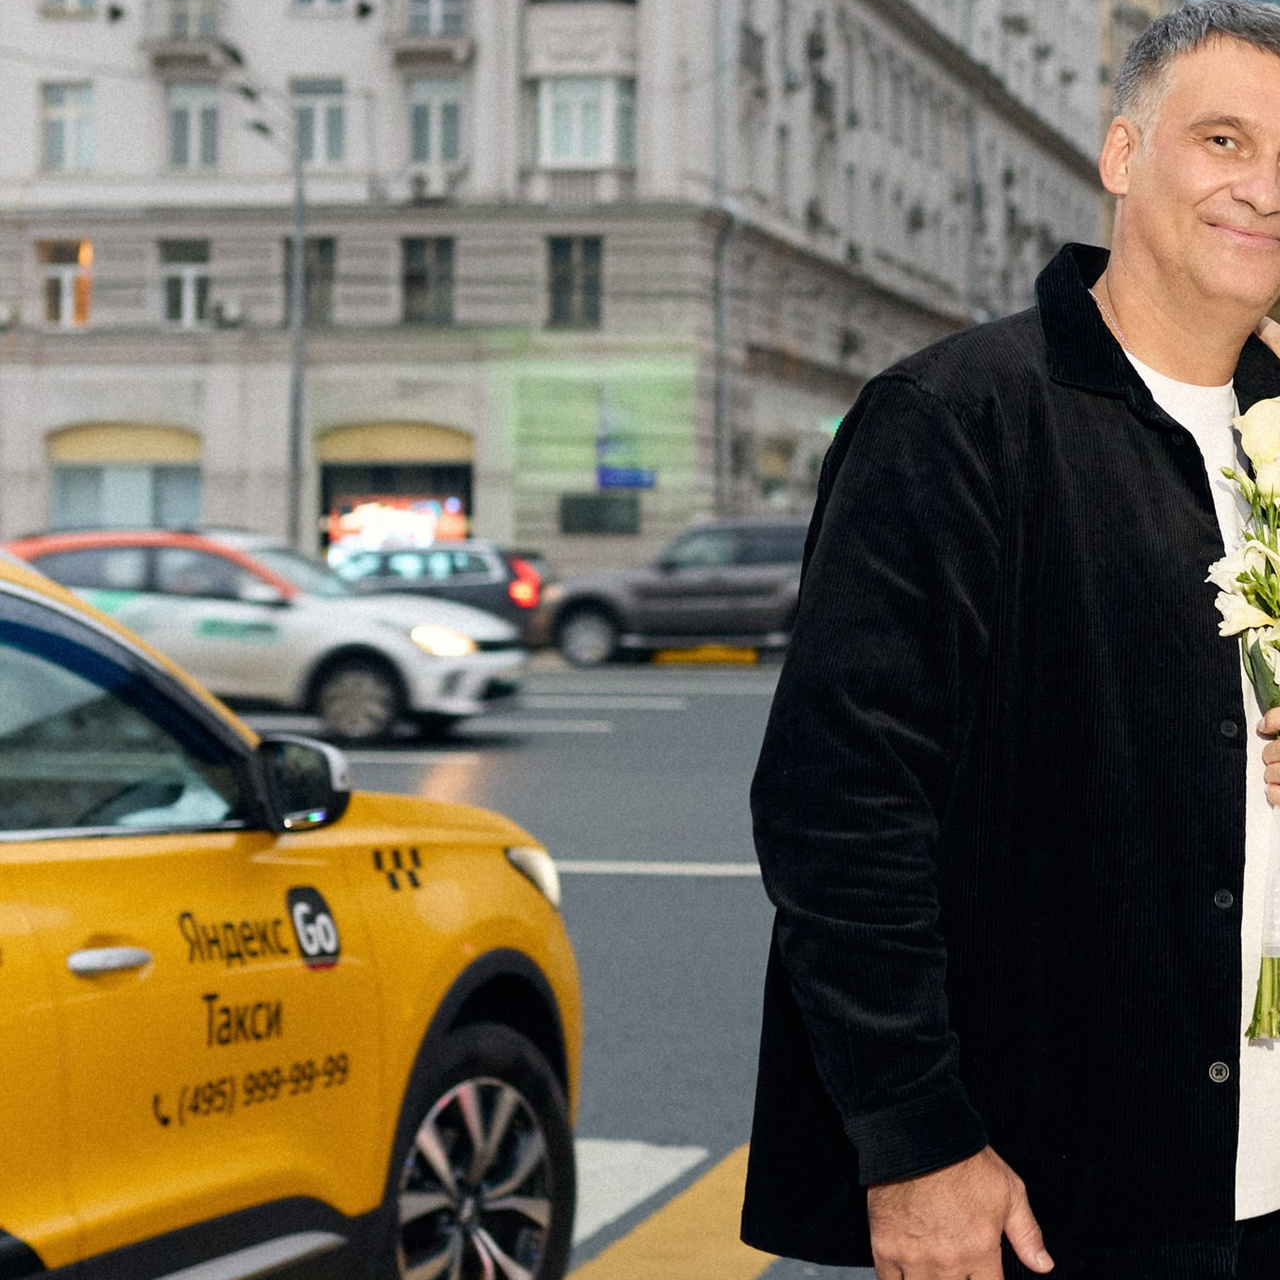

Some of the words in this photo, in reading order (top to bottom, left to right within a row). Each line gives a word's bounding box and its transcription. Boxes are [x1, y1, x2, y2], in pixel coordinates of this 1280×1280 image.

[178, 911, 289, 967] Яндекс
[292, 901, 341, 956] Go
[202, 993, 283, 1048] Такси
[177, 1076, 236, 1127] (495)
[243, 1052, 350, 1106] 999-99-99
